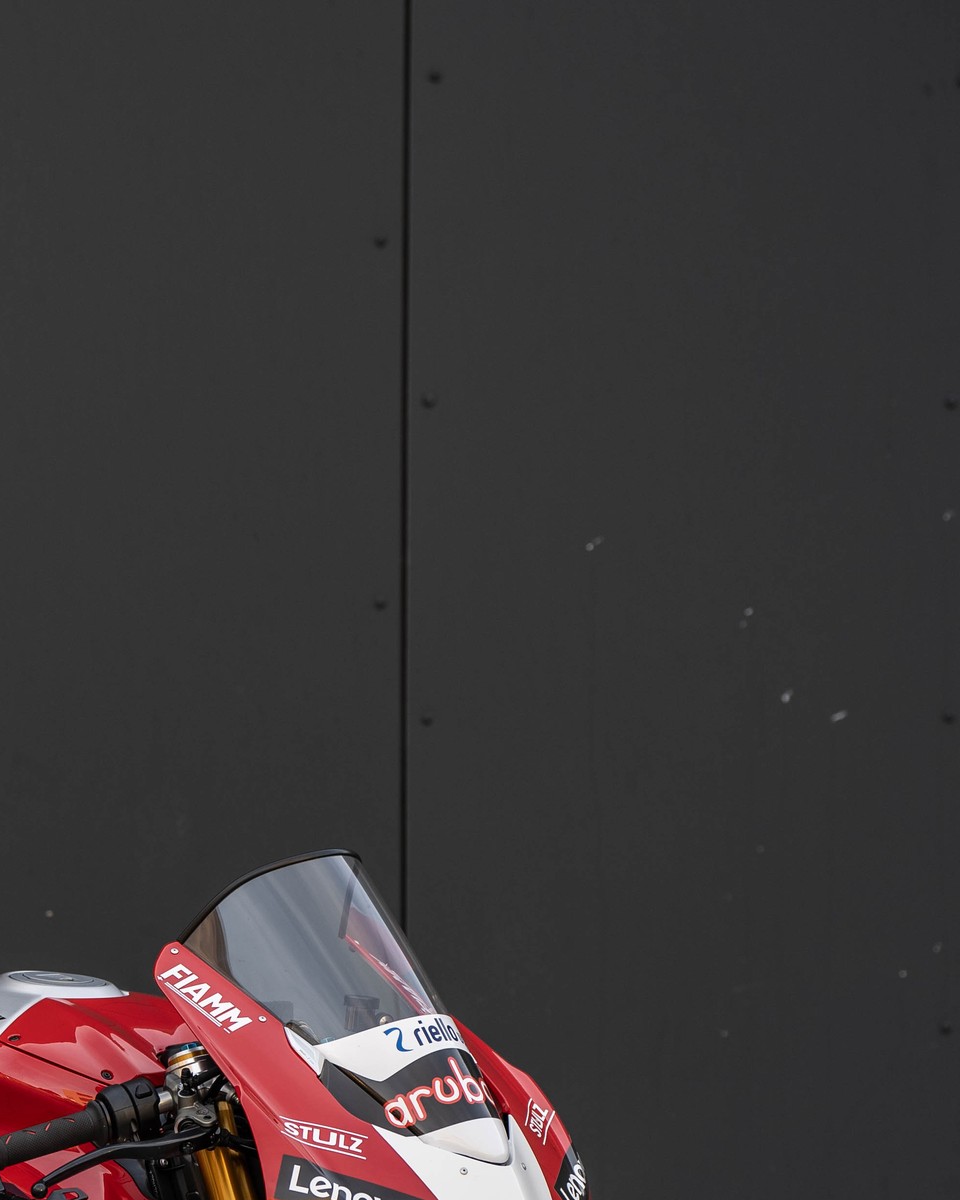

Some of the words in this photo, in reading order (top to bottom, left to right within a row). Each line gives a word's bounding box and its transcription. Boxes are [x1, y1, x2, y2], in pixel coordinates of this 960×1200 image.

[161, 963, 253, 1033] FIAMM
[413, 1017, 459, 1047] riello
[283, 1121, 365, 1154] STULZ
